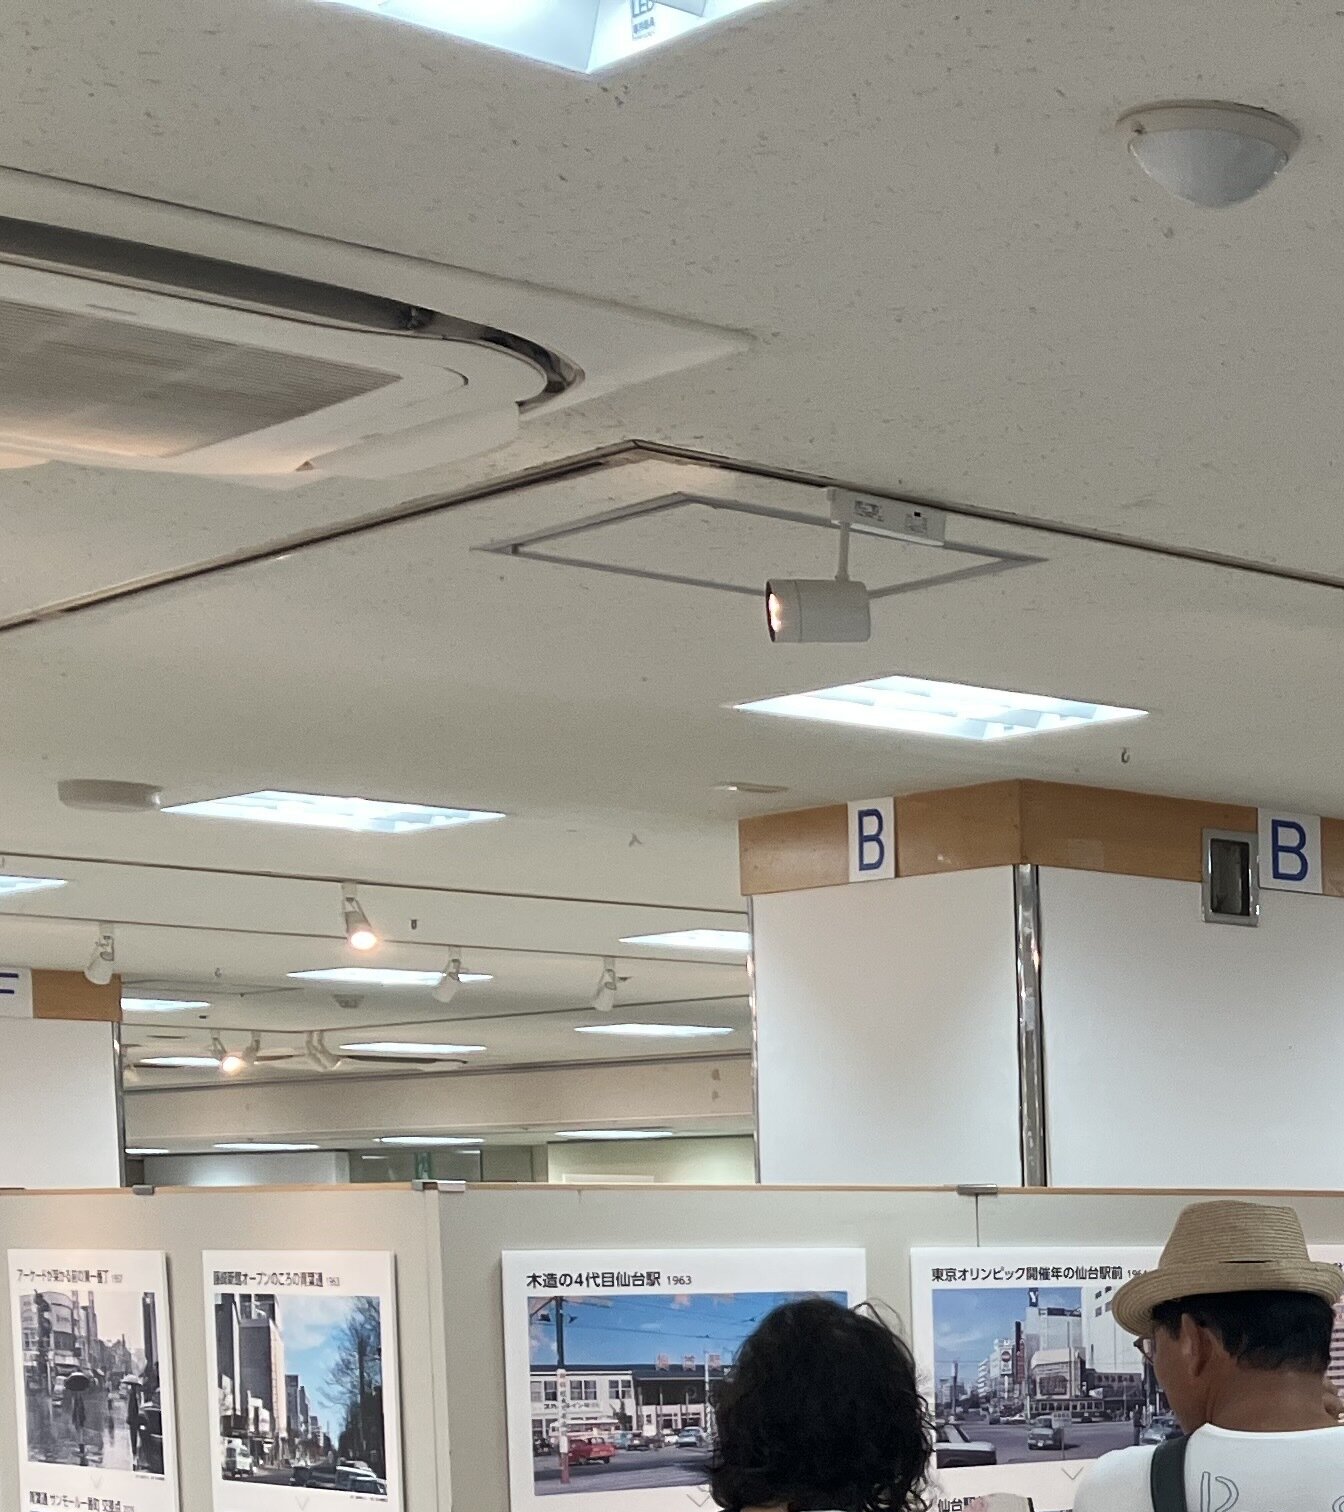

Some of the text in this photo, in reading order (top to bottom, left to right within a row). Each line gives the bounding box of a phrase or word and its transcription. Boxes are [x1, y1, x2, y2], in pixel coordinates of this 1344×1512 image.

[857, 808, 885, 872] B
[1270, 818, 1309, 882] B
[526, 1271, 692, 1289] 木造の4代目仙台駅 1963
[931, 1266, 1123, 1282] 東京オリンピック開催年の仙台駅前
